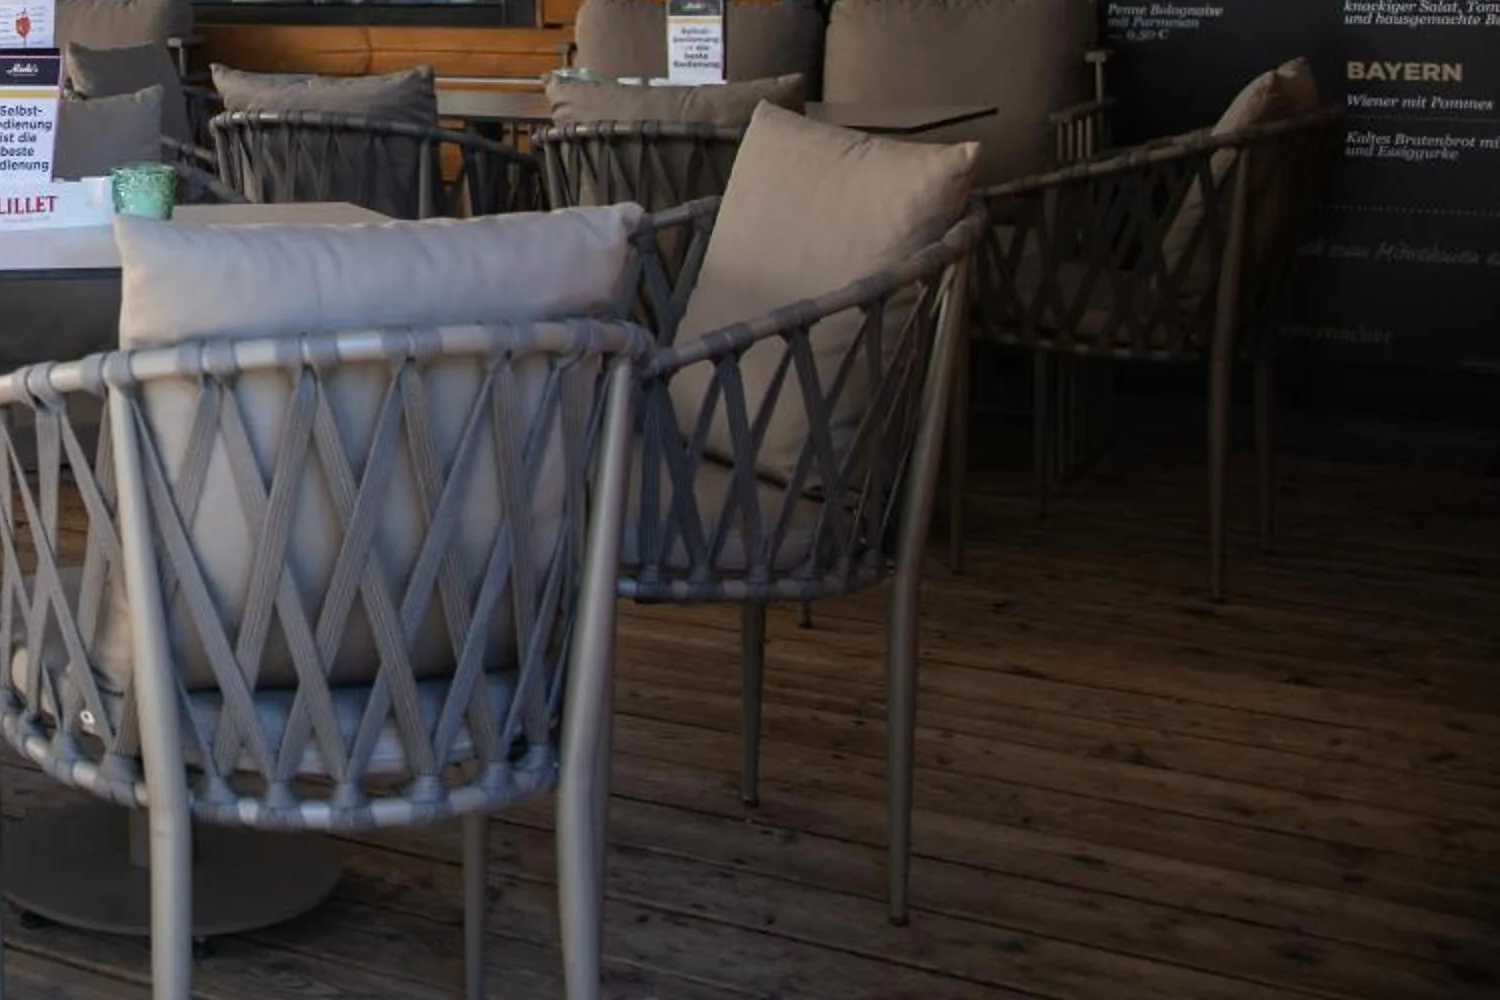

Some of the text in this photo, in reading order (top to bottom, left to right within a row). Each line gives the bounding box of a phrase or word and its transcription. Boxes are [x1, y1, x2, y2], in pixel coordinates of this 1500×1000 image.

[1347, 60, 1463, 83] BAYERN
[0, 104, 43, 117] Selbst-
[17, 131, 38, 143] die
[0, 145, 36, 157] beste
